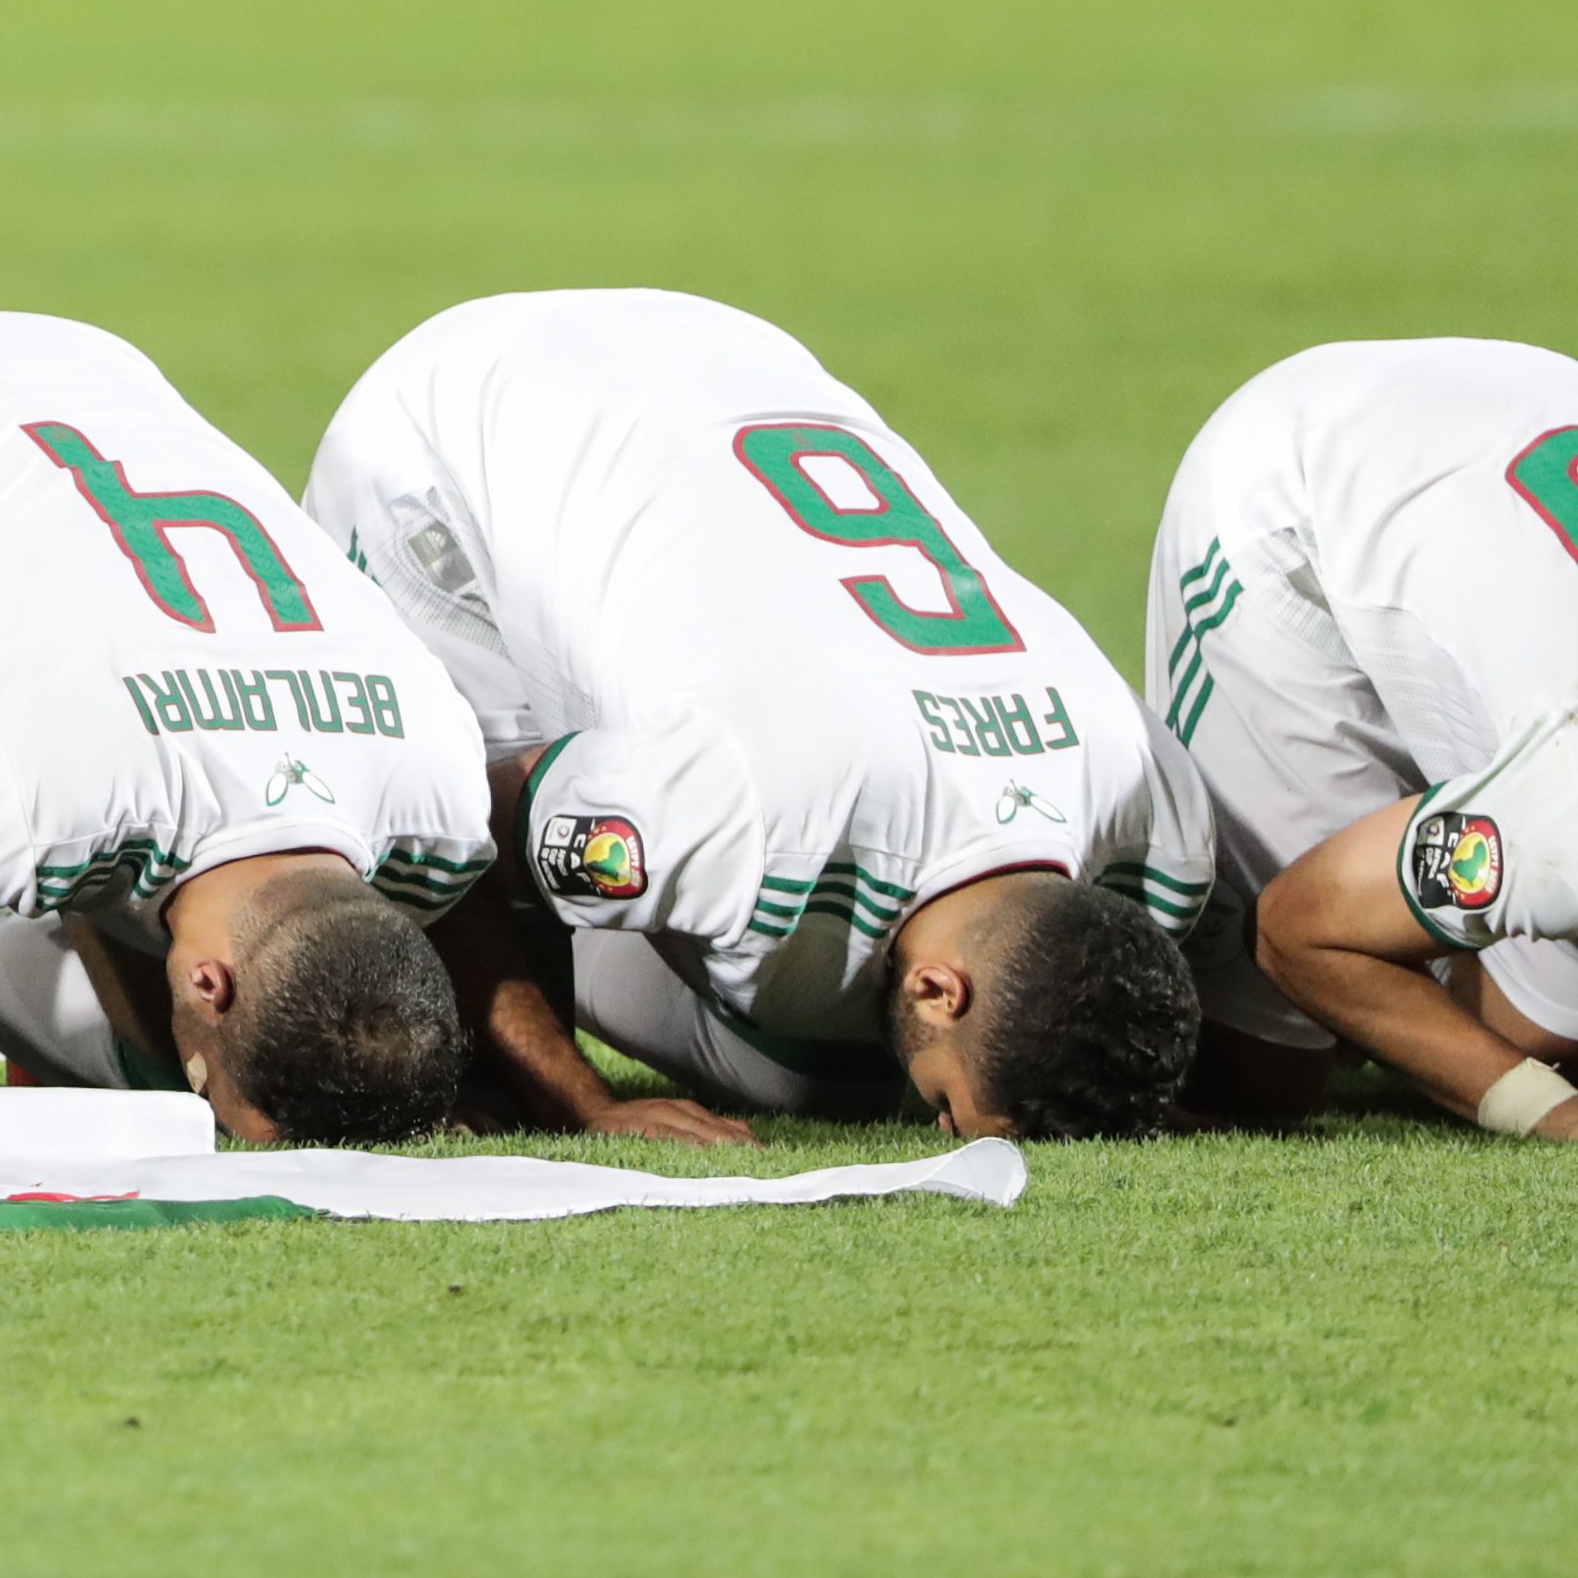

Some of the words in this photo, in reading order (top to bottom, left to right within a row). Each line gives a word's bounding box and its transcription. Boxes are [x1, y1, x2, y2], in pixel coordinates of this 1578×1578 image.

[19, 420, 324, 633] 4
[732, 423, 1026, 656] 6
[124, 669, 404, 739] BENLAMRI
[911, 686, 1080, 757] FARES
[570, 833, 591, 883] CAF
